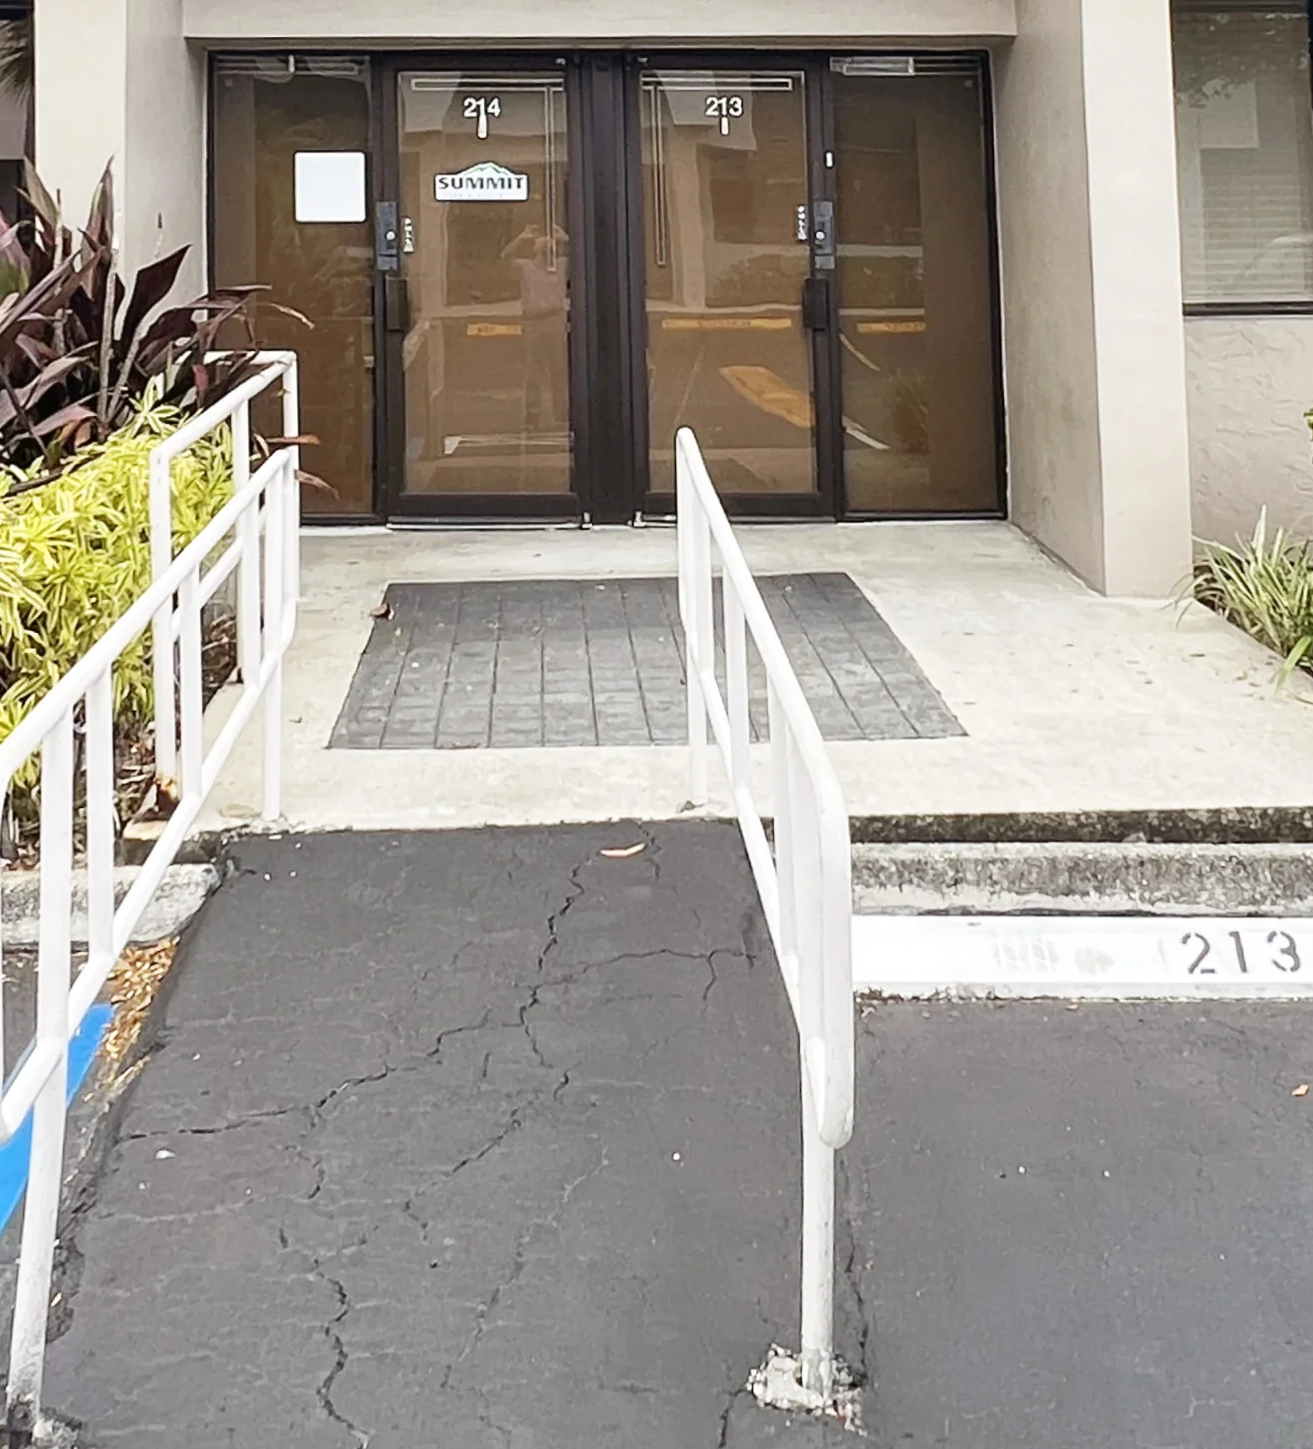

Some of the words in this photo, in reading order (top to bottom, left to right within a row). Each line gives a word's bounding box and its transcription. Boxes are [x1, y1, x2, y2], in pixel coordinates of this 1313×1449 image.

[463, 97, 501, 119] 214
[705, 96, 743, 117] 213
[438, 177, 524, 190] SUMMIT
[1181, 930, 1302, 974] 213
